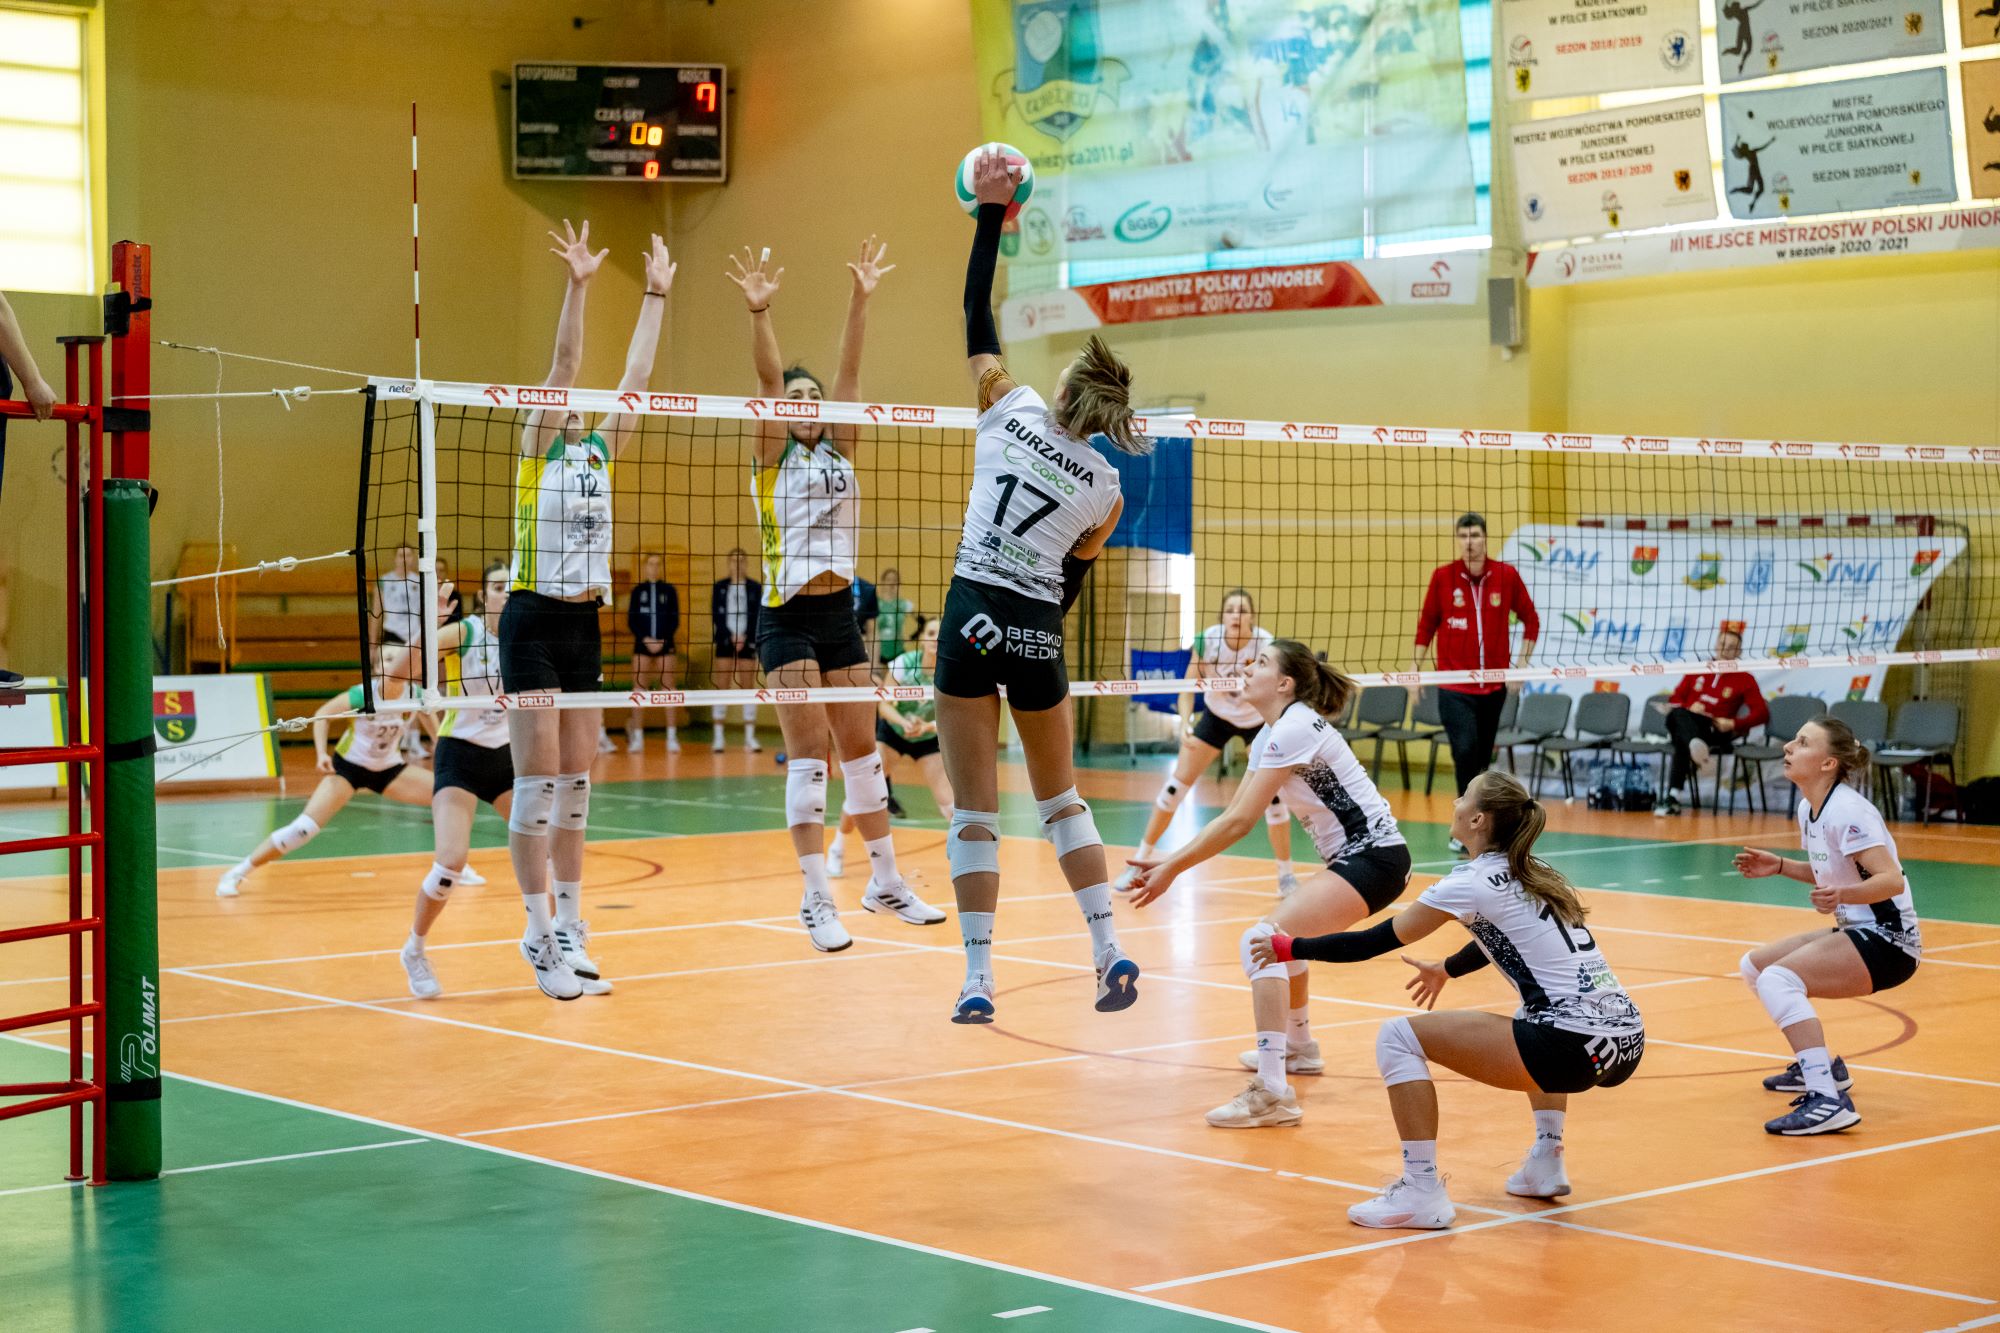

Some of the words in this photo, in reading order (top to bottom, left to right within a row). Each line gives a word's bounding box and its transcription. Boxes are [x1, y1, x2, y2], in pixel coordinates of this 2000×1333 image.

[1548, 15, 1557, 25] W
[1591, 5, 1648, 21] SIATKOWEJ
[1801, 23, 1838, 40] SEZON
[1555, 42, 1588, 55] SEZON
[1832, 94, 1874, 109] MISTRZ
[1856, 100, 1946, 120] POMORSKIEGO
[1514, 132, 1548, 145] MISTRZ
[1626, 107, 1702, 127] POMORSKIEGO
[1824, 123, 1883, 140] JUNIORKA
[1581, 135, 1629, 150] JUNIOREK
[1799, 145, 1809, 156] W
[1849, 134, 1915, 151] SIATKOWEJ
[1559, 156, 1568, 167] W
[1599, 145, 1656, 161] SIATKOWEJ
[644, 161, 660, 179] 0
[1812, 170, 1852, 183] SEZON
[1854, 162, 1908, 178] 2020/2021
[1568, 171, 1599, 184] SEZON
[1127, 216, 1158, 231] SGB
[1688, 232, 1754, 250] MIEJSCE
[1759, 222, 1866, 245] MISTRZOSTW
[1872, 216, 1933, 236] POLSKI
[1777, 250, 1786, 259] w
[1789, 244, 1836, 258] sezonie
[1879, 237, 1909, 250] 2021
[1581, 253, 1623, 265] POLSKA
[1195, 272, 1248, 292] POLSKI
[1250, 268, 1324, 288] JUNIOREK
[1413, 285, 1449, 297] ORLEN
[519, 390, 566, 404] ORLEN
[651, 396, 695, 411] ORLEN
[776, 403, 818, 417] ORLEN
[893, 409, 933, 423] ORLEN
[1210, 422, 1243, 435] ORLEN
[1305, 428, 1337, 441] ORLEN
[1395, 432, 1426, 442] ORLEN
[1481, 435, 1509, 444] ORLEN
[1563, 438, 1591, 447] ORLEN
[1642, 440, 1667, 450] ORLEN
[1716, 443, 1741, 452] ORLEN
[1788, 445, 1811, 454] ORLEN
[1004, 418, 1094, 488] BURZAWA
[1856, 448, 1879, 457] ORLEN
[1922, 450, 1943, 458] ORLEN
[576, 473, 602, 497] 12
[821, 468, 846, 494] 13
[995, 473, 1060, 537] 17
[653, 692, 682, 703] ORLEN
[778, 691, 804, 700] ORLEN
[896, 689, 922, 698] ORLEN
[520, 697, 552, 706] ORLEN
[120, 975, 156, 1083] POLIMAT
